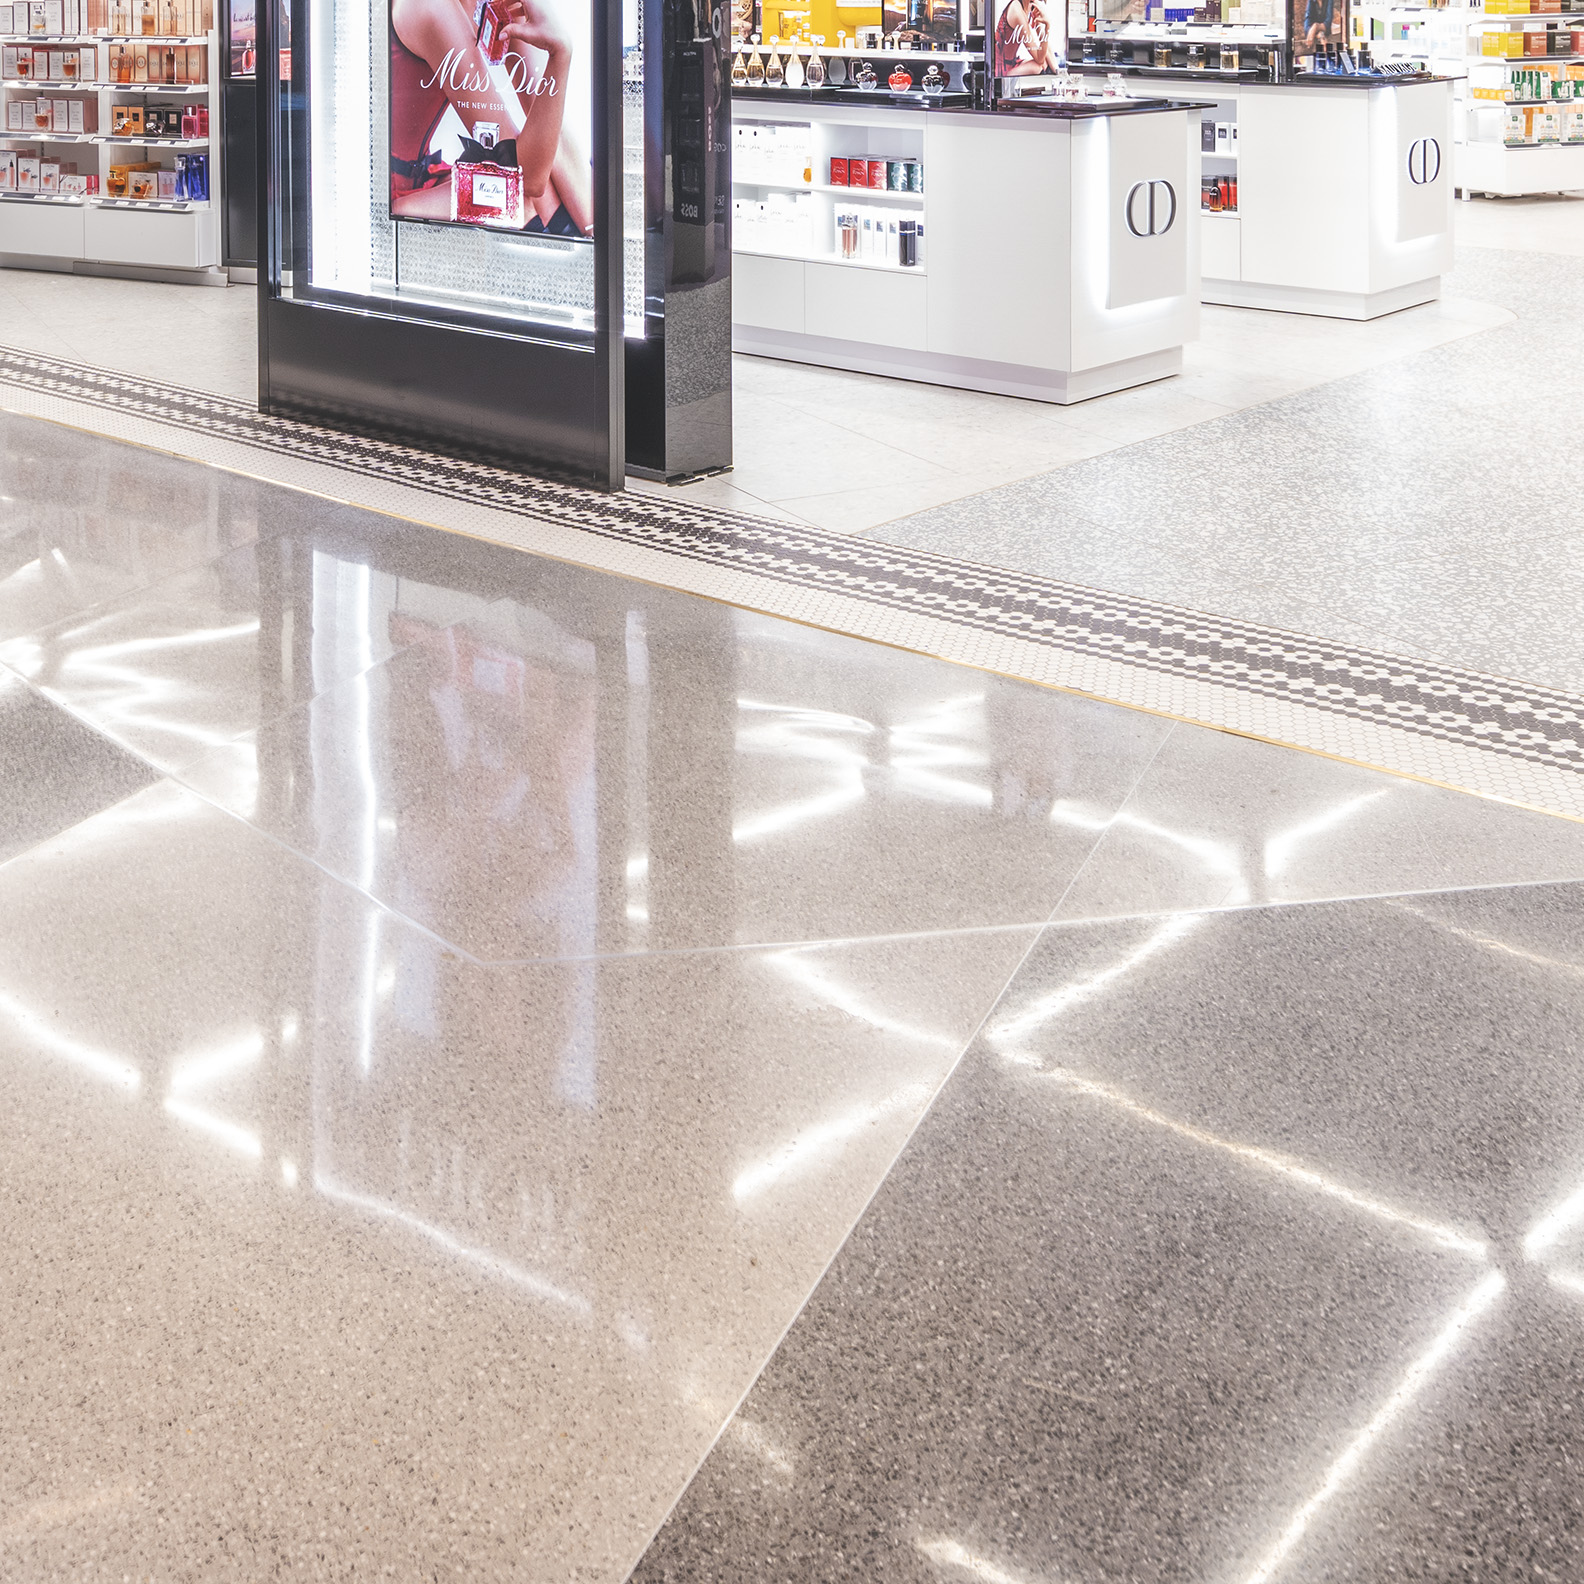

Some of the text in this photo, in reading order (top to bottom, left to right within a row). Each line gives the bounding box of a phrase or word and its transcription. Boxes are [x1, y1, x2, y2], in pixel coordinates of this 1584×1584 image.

[1005, 25, 1032, 44] Miss
[420, 48, 558, 97] Miss Dior
[490, 103, 509, 111] ESSE
